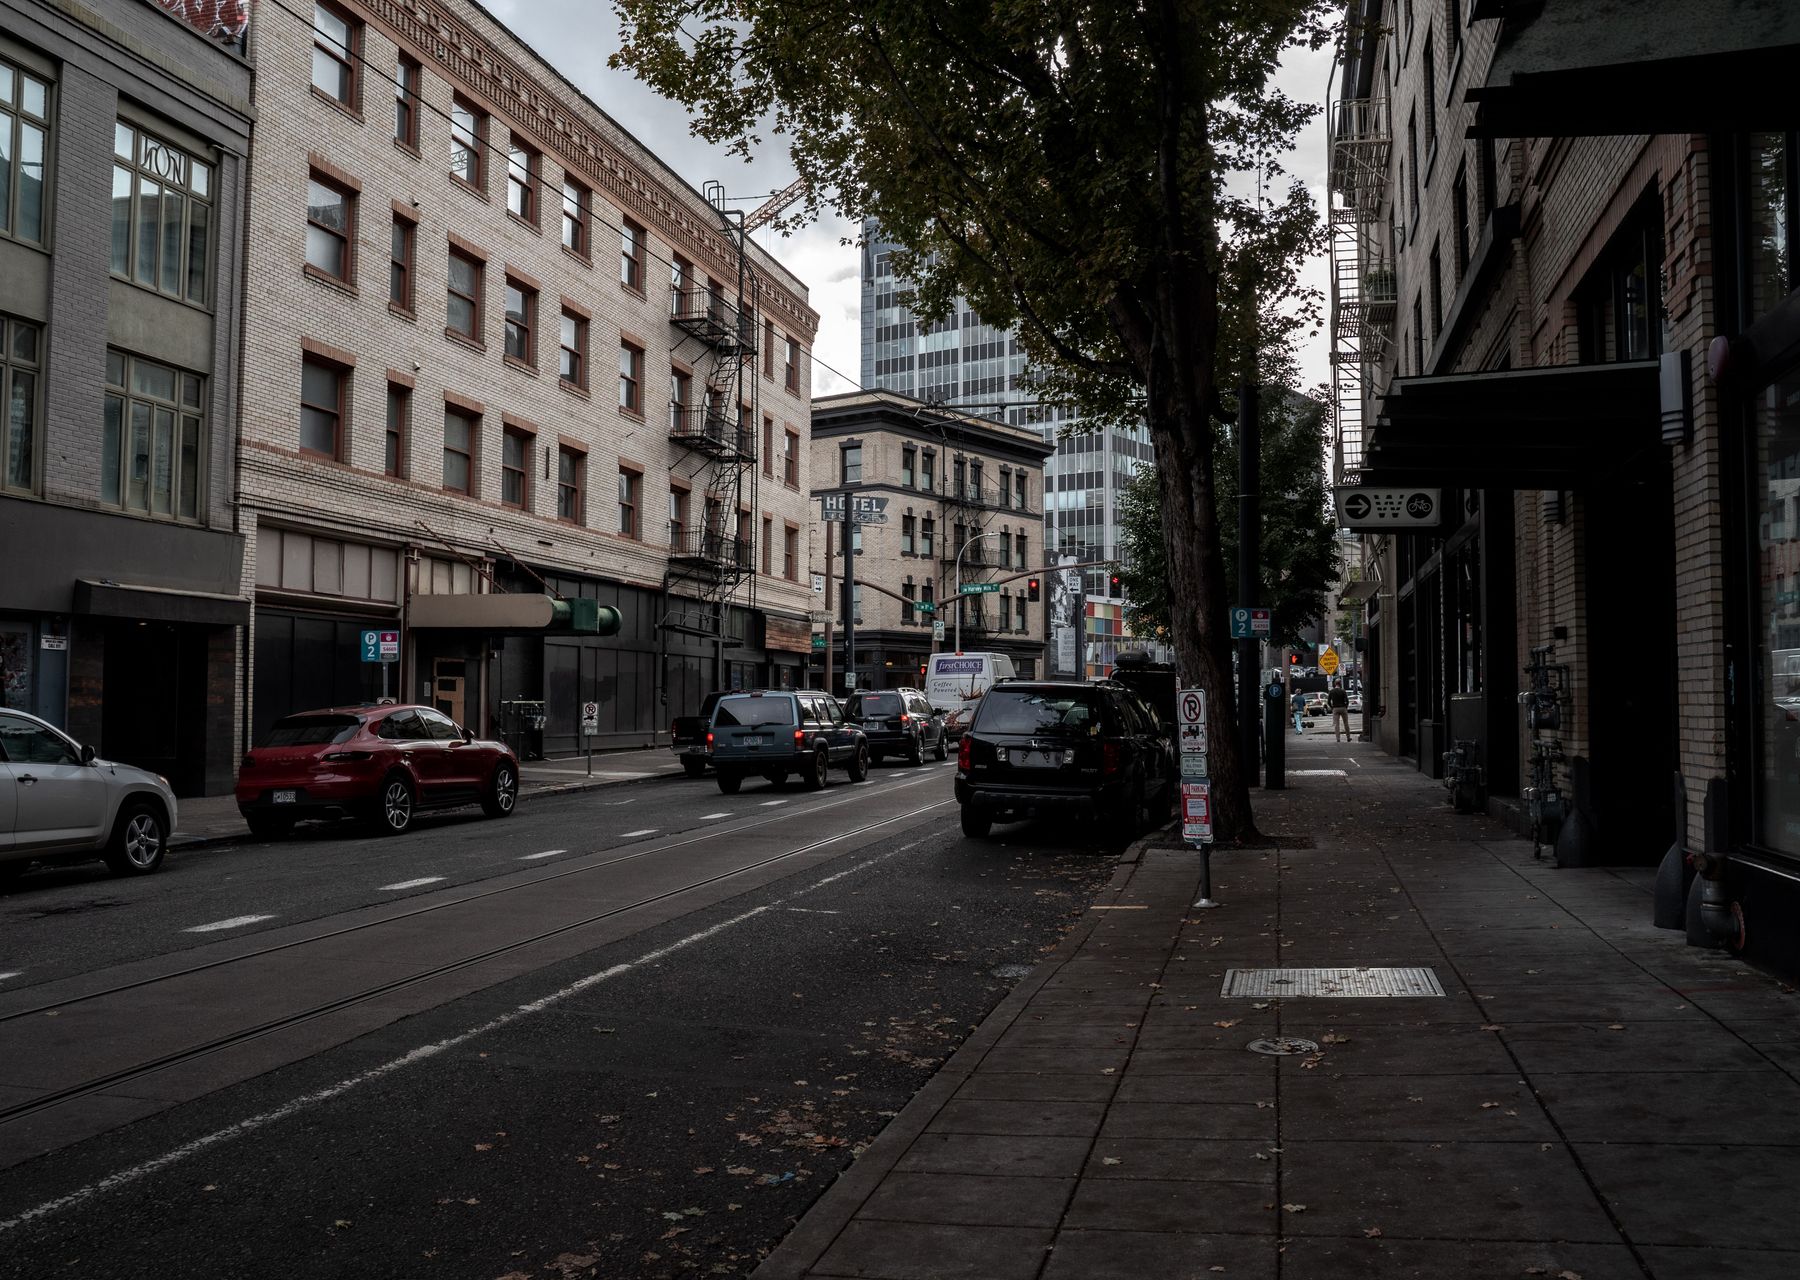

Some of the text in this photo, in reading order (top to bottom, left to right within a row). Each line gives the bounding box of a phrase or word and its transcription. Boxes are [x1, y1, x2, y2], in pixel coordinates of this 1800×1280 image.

[826, 496, 881, 512] HOTEL
[1238, 623, 1246, 633] 2
[367, 646, 375, 657] 2
[937, 660, 982, 671] firstCHOICE
[1191, 785, 1206, 793] PARKING
